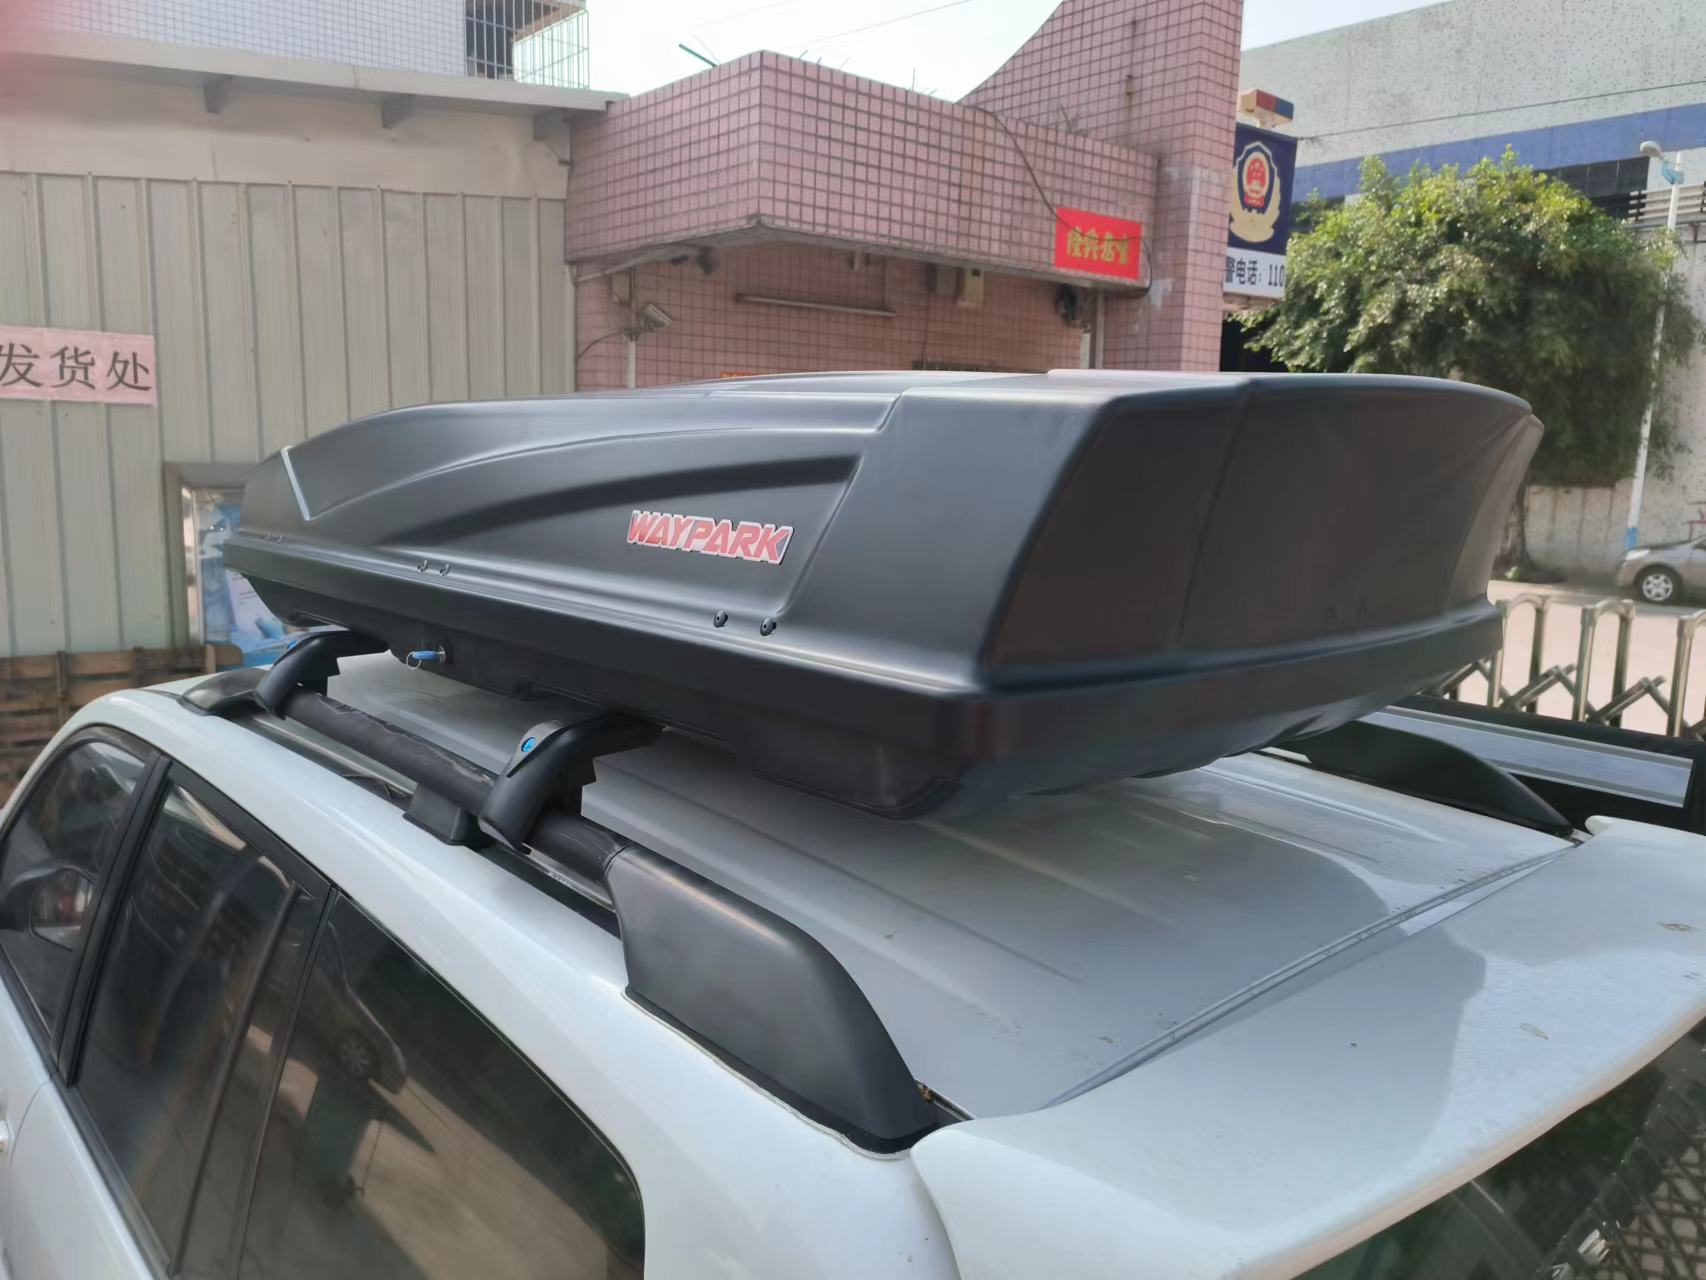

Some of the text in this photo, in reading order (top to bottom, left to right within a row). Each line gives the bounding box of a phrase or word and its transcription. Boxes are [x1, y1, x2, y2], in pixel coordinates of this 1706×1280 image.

[0, 342, 152, 391] 发货处
[627, 510, 793, 565] WAYPARK
